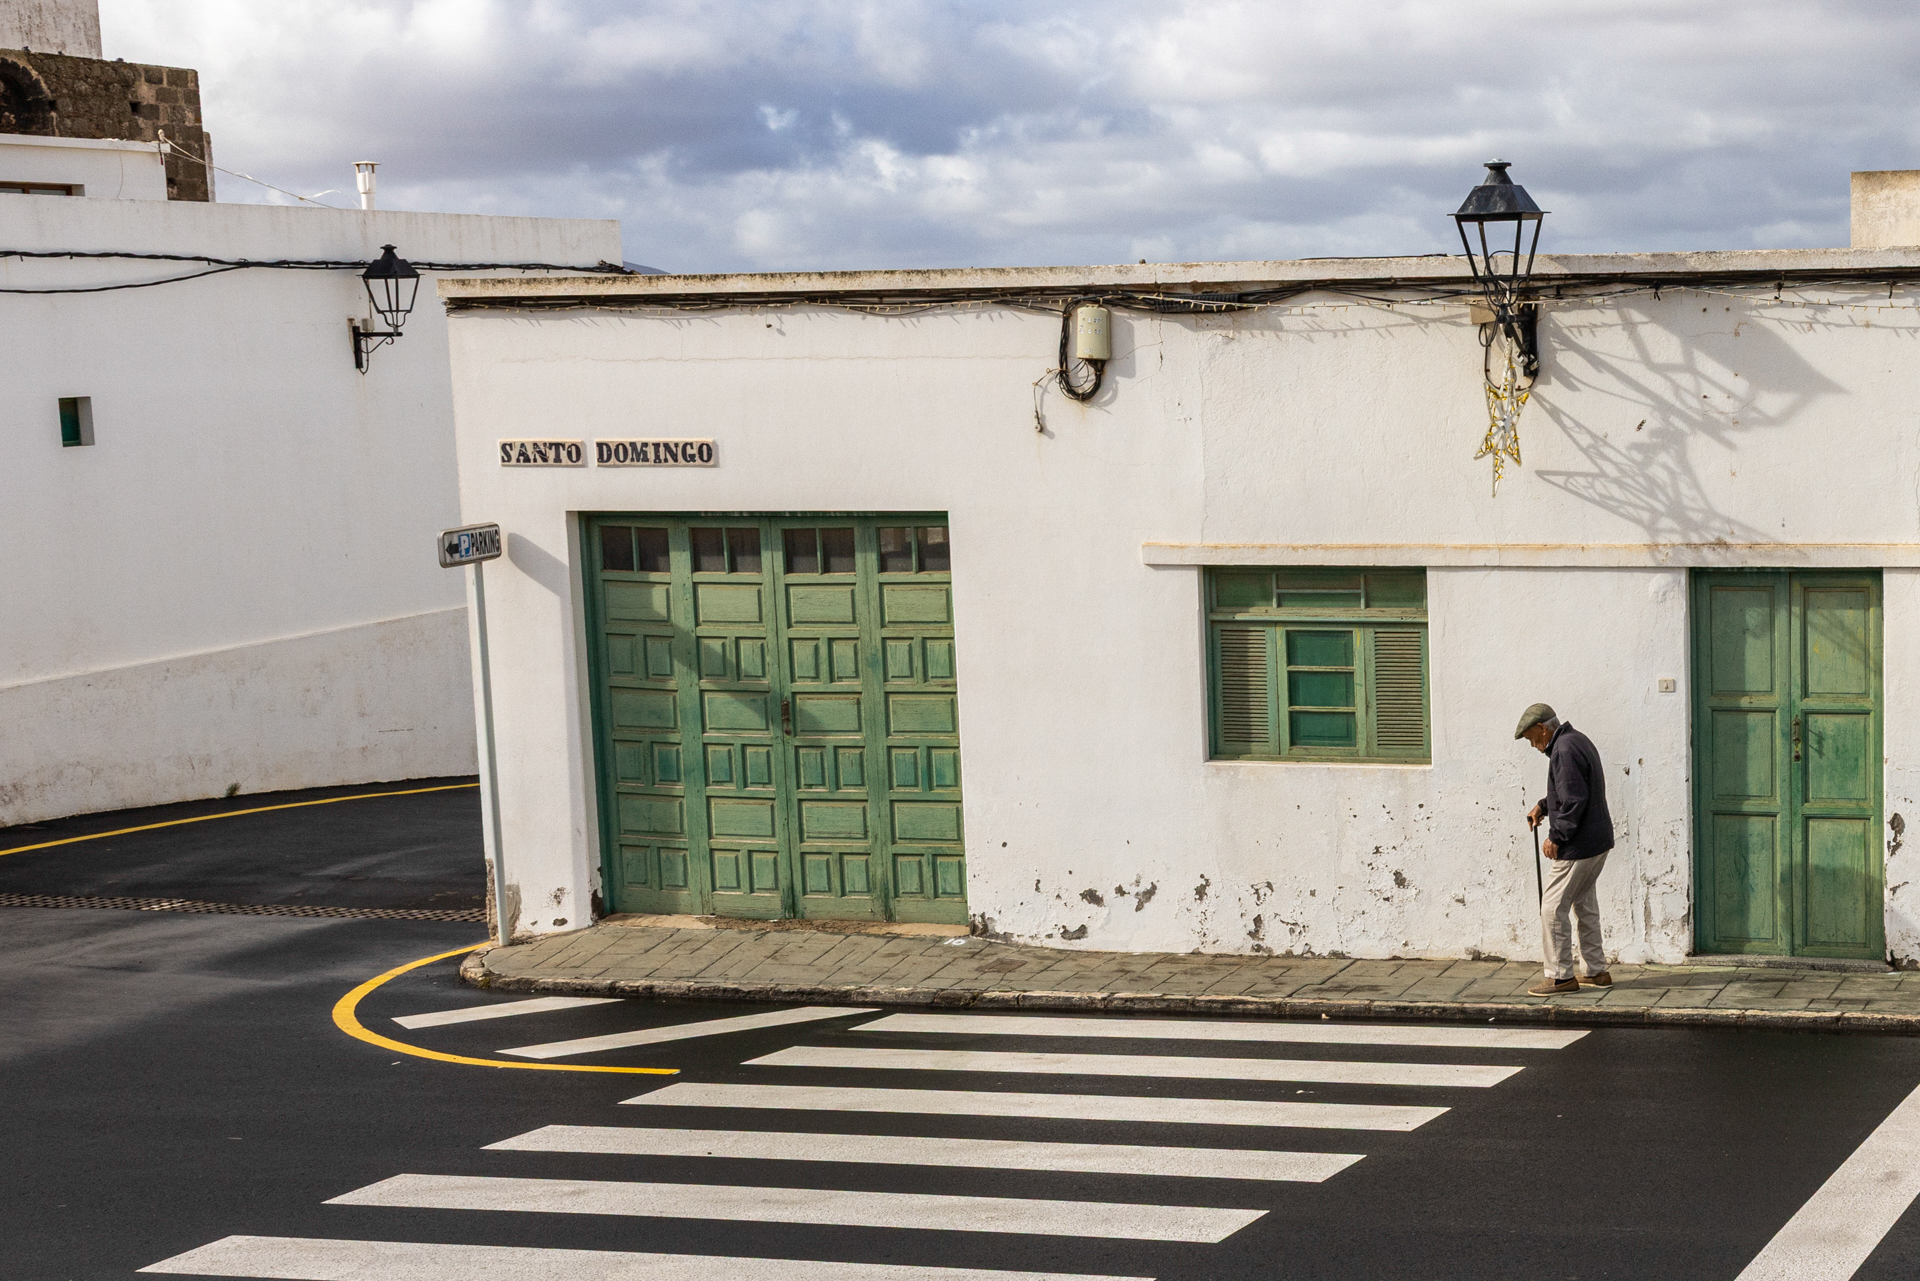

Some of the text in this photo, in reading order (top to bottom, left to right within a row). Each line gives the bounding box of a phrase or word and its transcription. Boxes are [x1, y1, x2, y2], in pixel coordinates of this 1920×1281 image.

[500, 441, 713, 464] SANTO DOMINGO
[460, 529, 500, 557] P PARKING
